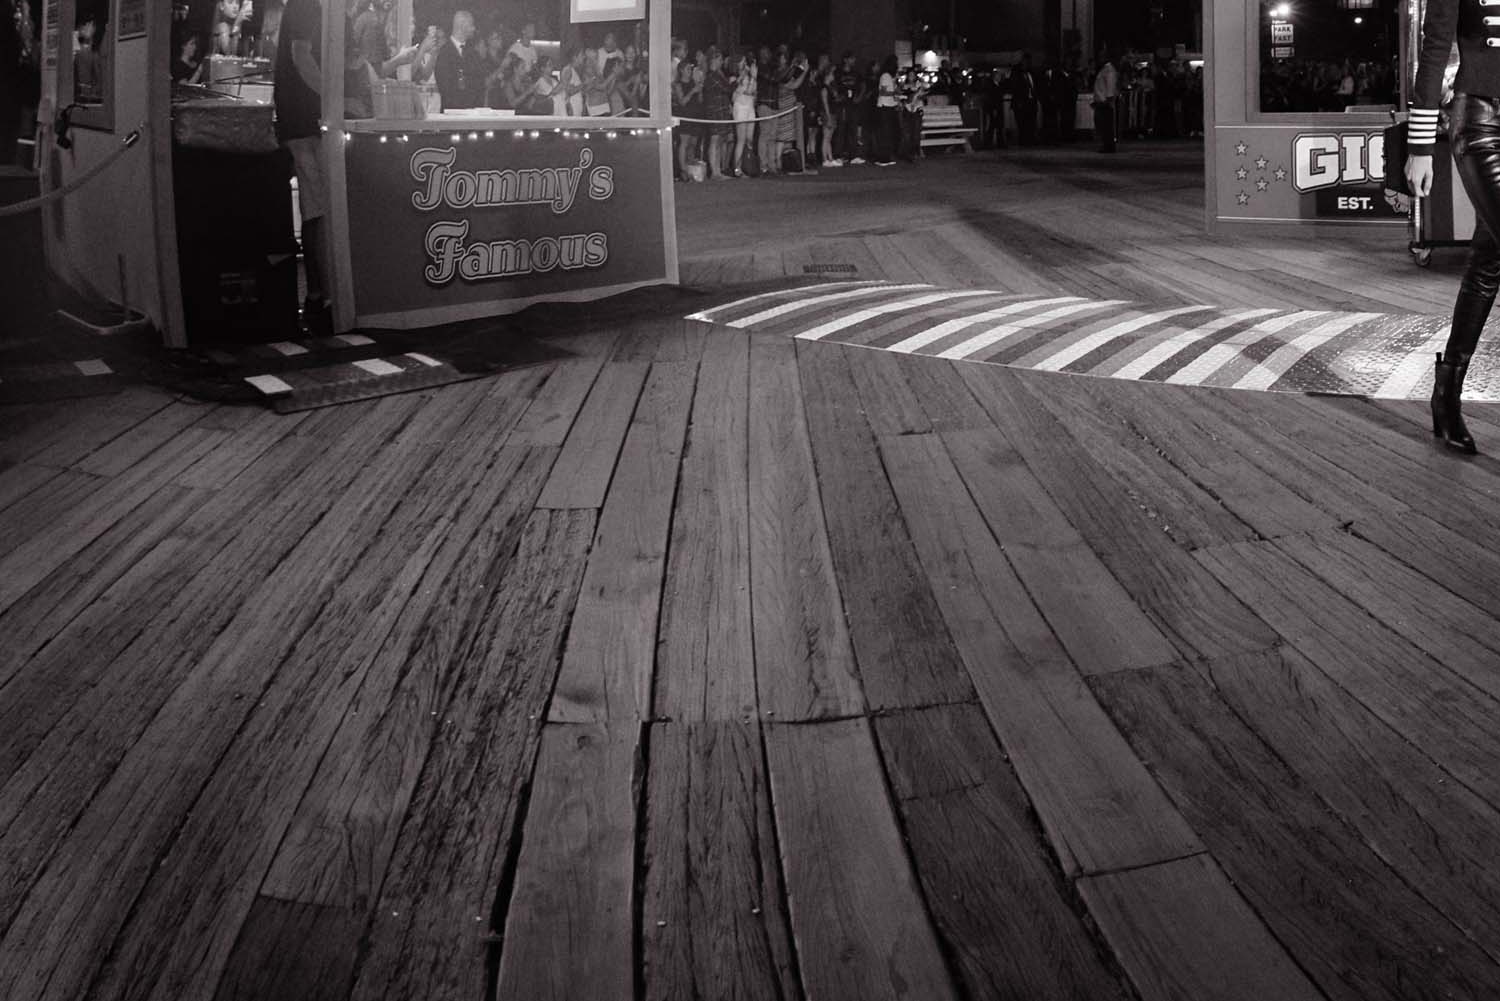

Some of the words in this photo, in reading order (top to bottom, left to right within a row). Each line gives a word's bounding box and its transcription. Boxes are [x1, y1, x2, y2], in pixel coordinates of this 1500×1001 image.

[410, 147, 613, 213] Tommy's
[1337, 196, 1374, 210] EST.
[425, 219, 608, 284] Famous
